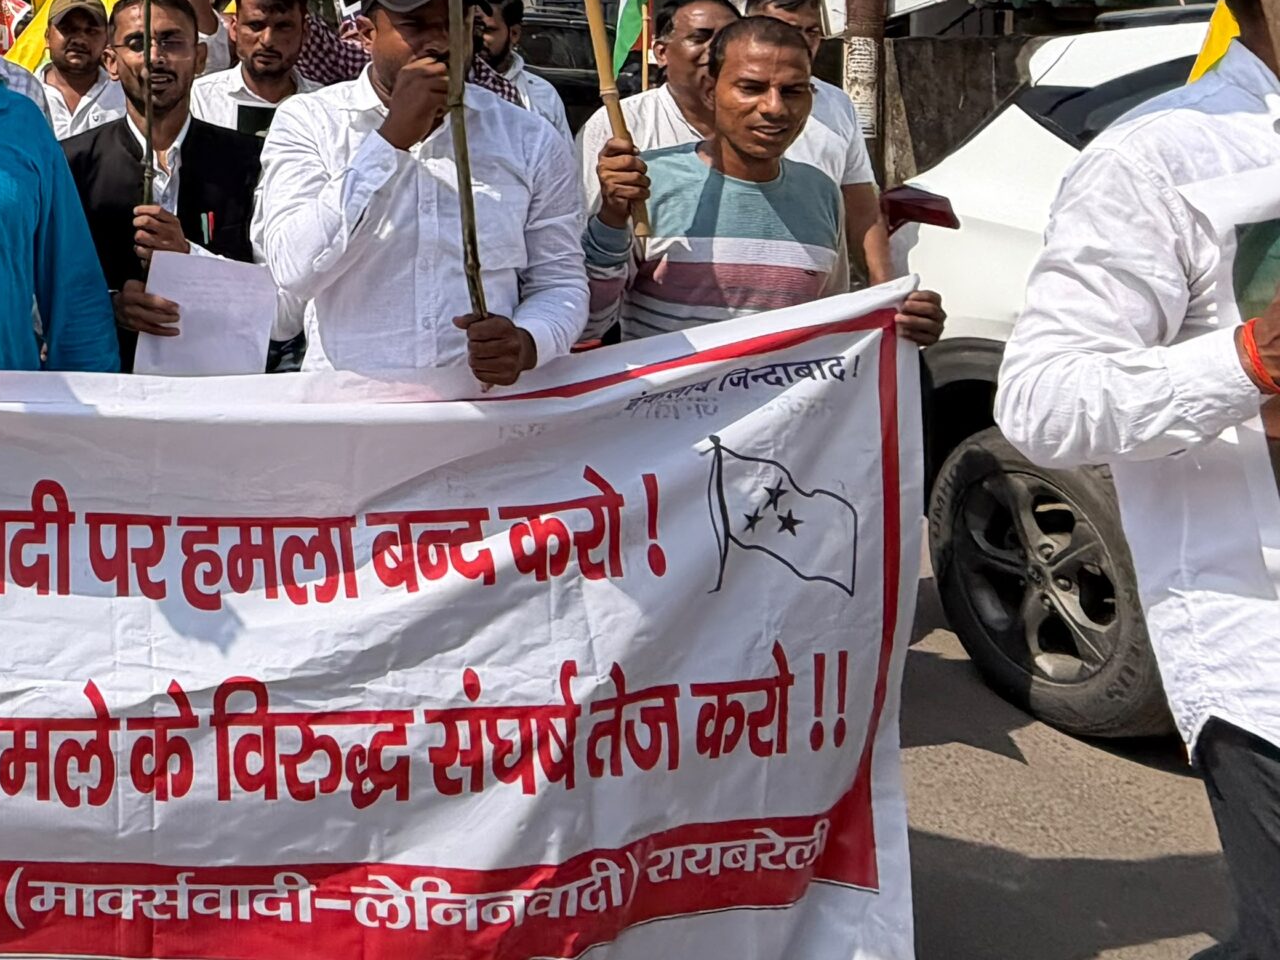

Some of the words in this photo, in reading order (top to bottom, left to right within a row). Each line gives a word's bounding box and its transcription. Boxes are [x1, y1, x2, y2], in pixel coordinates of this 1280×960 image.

[84, 512, 172, 600] पर
[177, 515, 357, 611] हमला
[365, 507, 496, 593] बन्द
[126, 678, 199, 801] के
[210, 676, 414, 809] विरुद्ध
[423, 660, 582, 796] संघर्ष
[585, 661, 680, 778] तेज
[646, 819, 831, 884] रायबरेली
